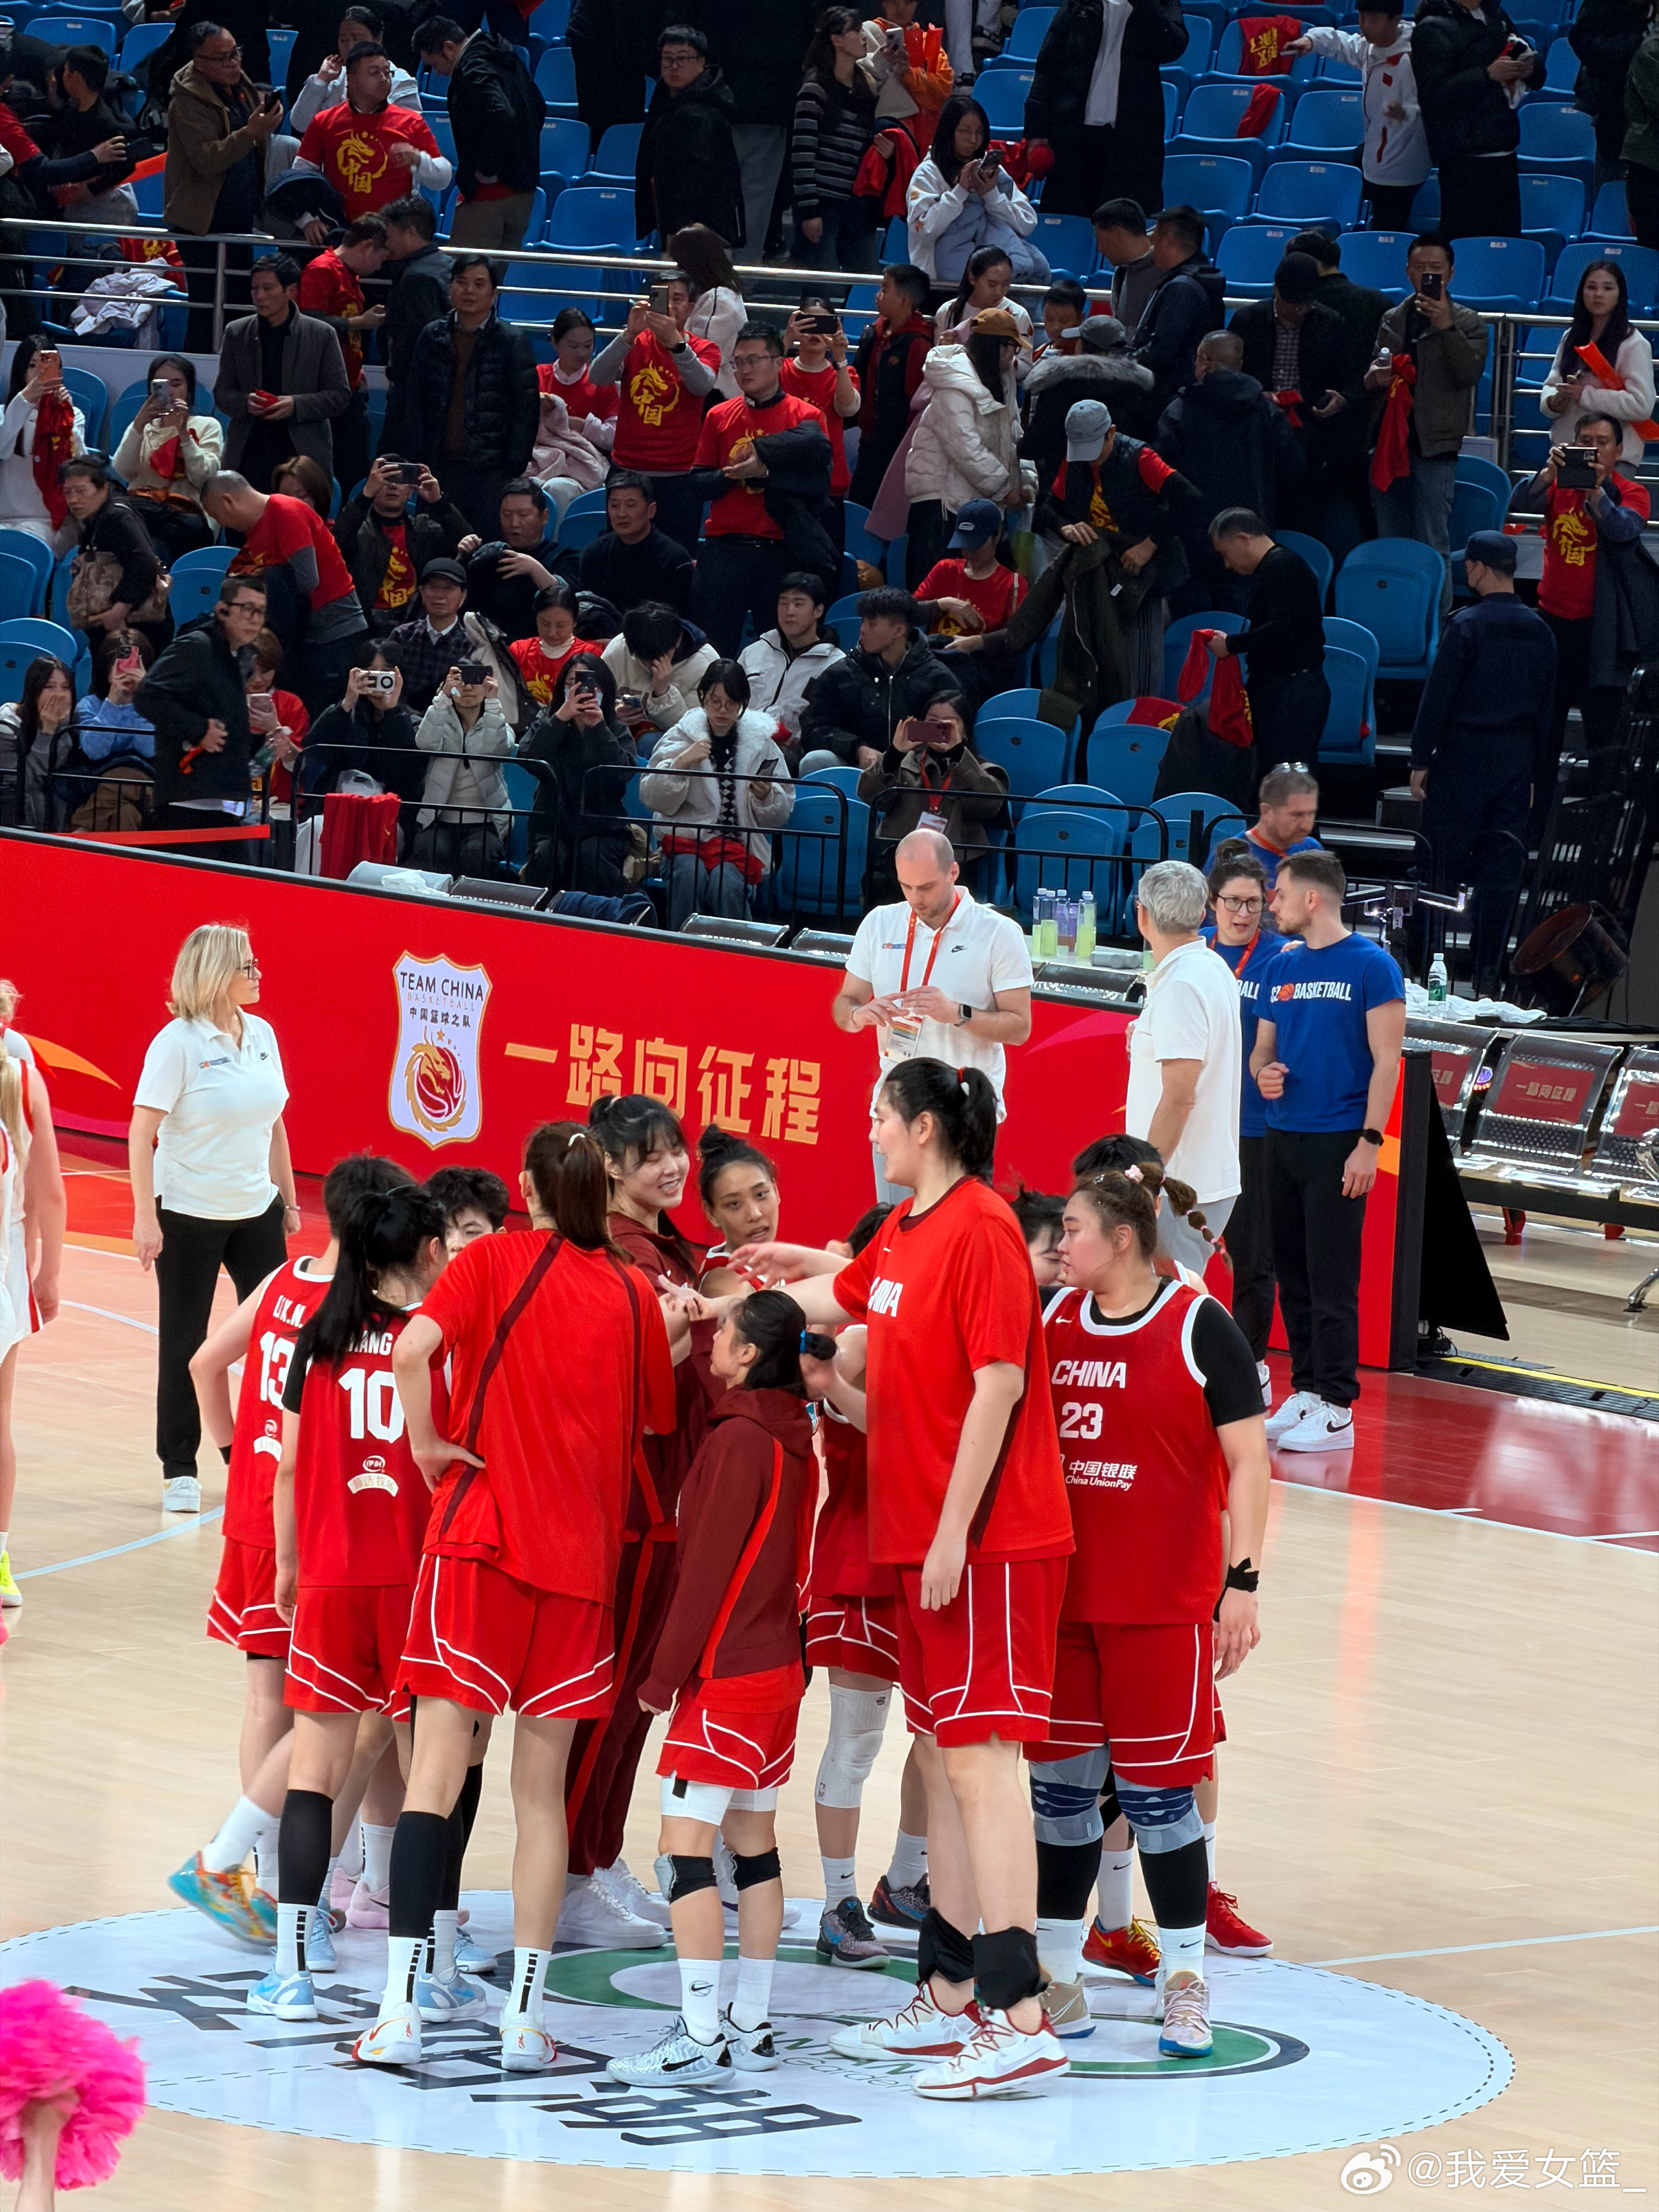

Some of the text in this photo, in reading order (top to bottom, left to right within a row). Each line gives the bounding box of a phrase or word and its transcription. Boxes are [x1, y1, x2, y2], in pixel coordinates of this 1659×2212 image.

[342, 158, 372, 194] 中国
[633, 388, 663, 426] 中国
[400, 972, 483, 1001] TEAM CHINA
[1293, 981, 1352, 1001] BASKETBALL
[408, 992, 475, 1012] BASKETBALL
[410, 1006, 471, 1028] 中国篮球之队
[505, 1024, 821, 1145] 一路向征程
[259, 1331, 296, 1410] 13
[1051, 1360, 1127, 1389] CHINA
[338, 1368, 405, 1443] 10
[1059, 1402, 1103, 1440] 23
[1065, 1475, 1132, 1491] China UnionPay
[1069, 1460, 1137, 1480] 中国银联
